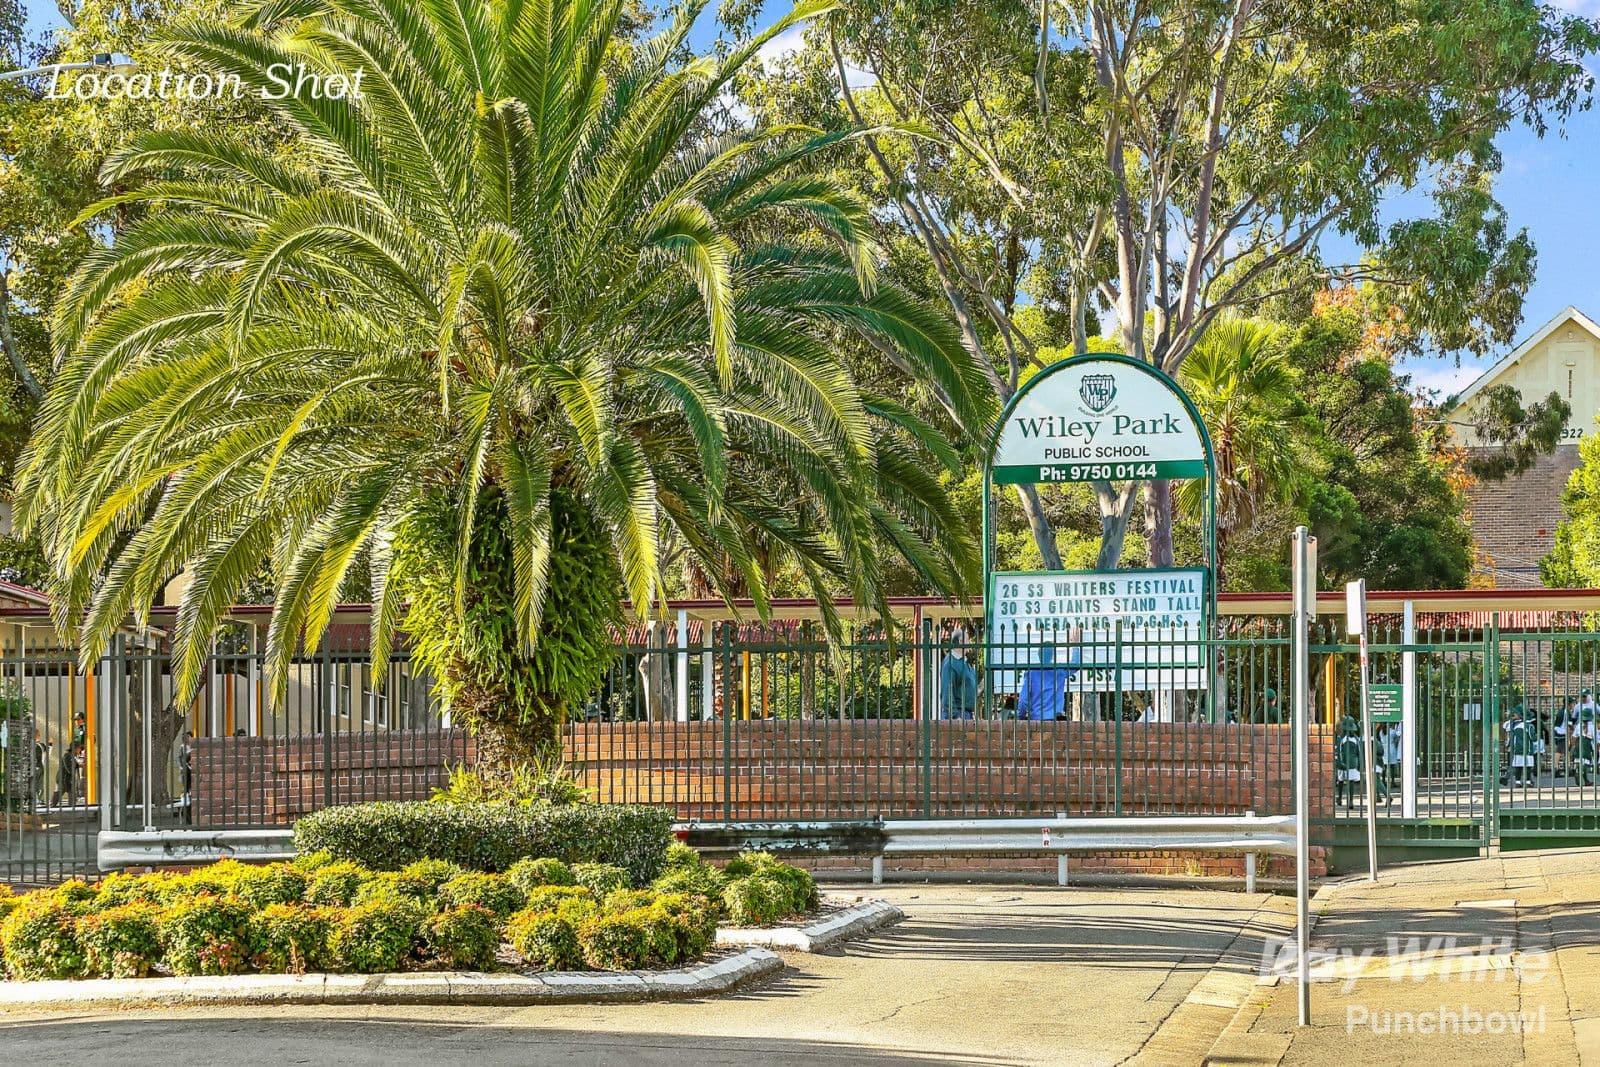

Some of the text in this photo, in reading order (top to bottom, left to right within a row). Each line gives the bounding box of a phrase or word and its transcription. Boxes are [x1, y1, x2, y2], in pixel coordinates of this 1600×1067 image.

[1015, 412, 1183, 445] Wiley Park
[1044, 445, 1150, 460] PUBLIC SCHOOL
[1039, 463, 1158, 481] Ph: 9750 0144
[1003, 579, 1195, 598] 26 S3 WRITERS FESTIVAL
[1001, 596, 1201, 615] 30 S3 GIANTS STAND TALL
